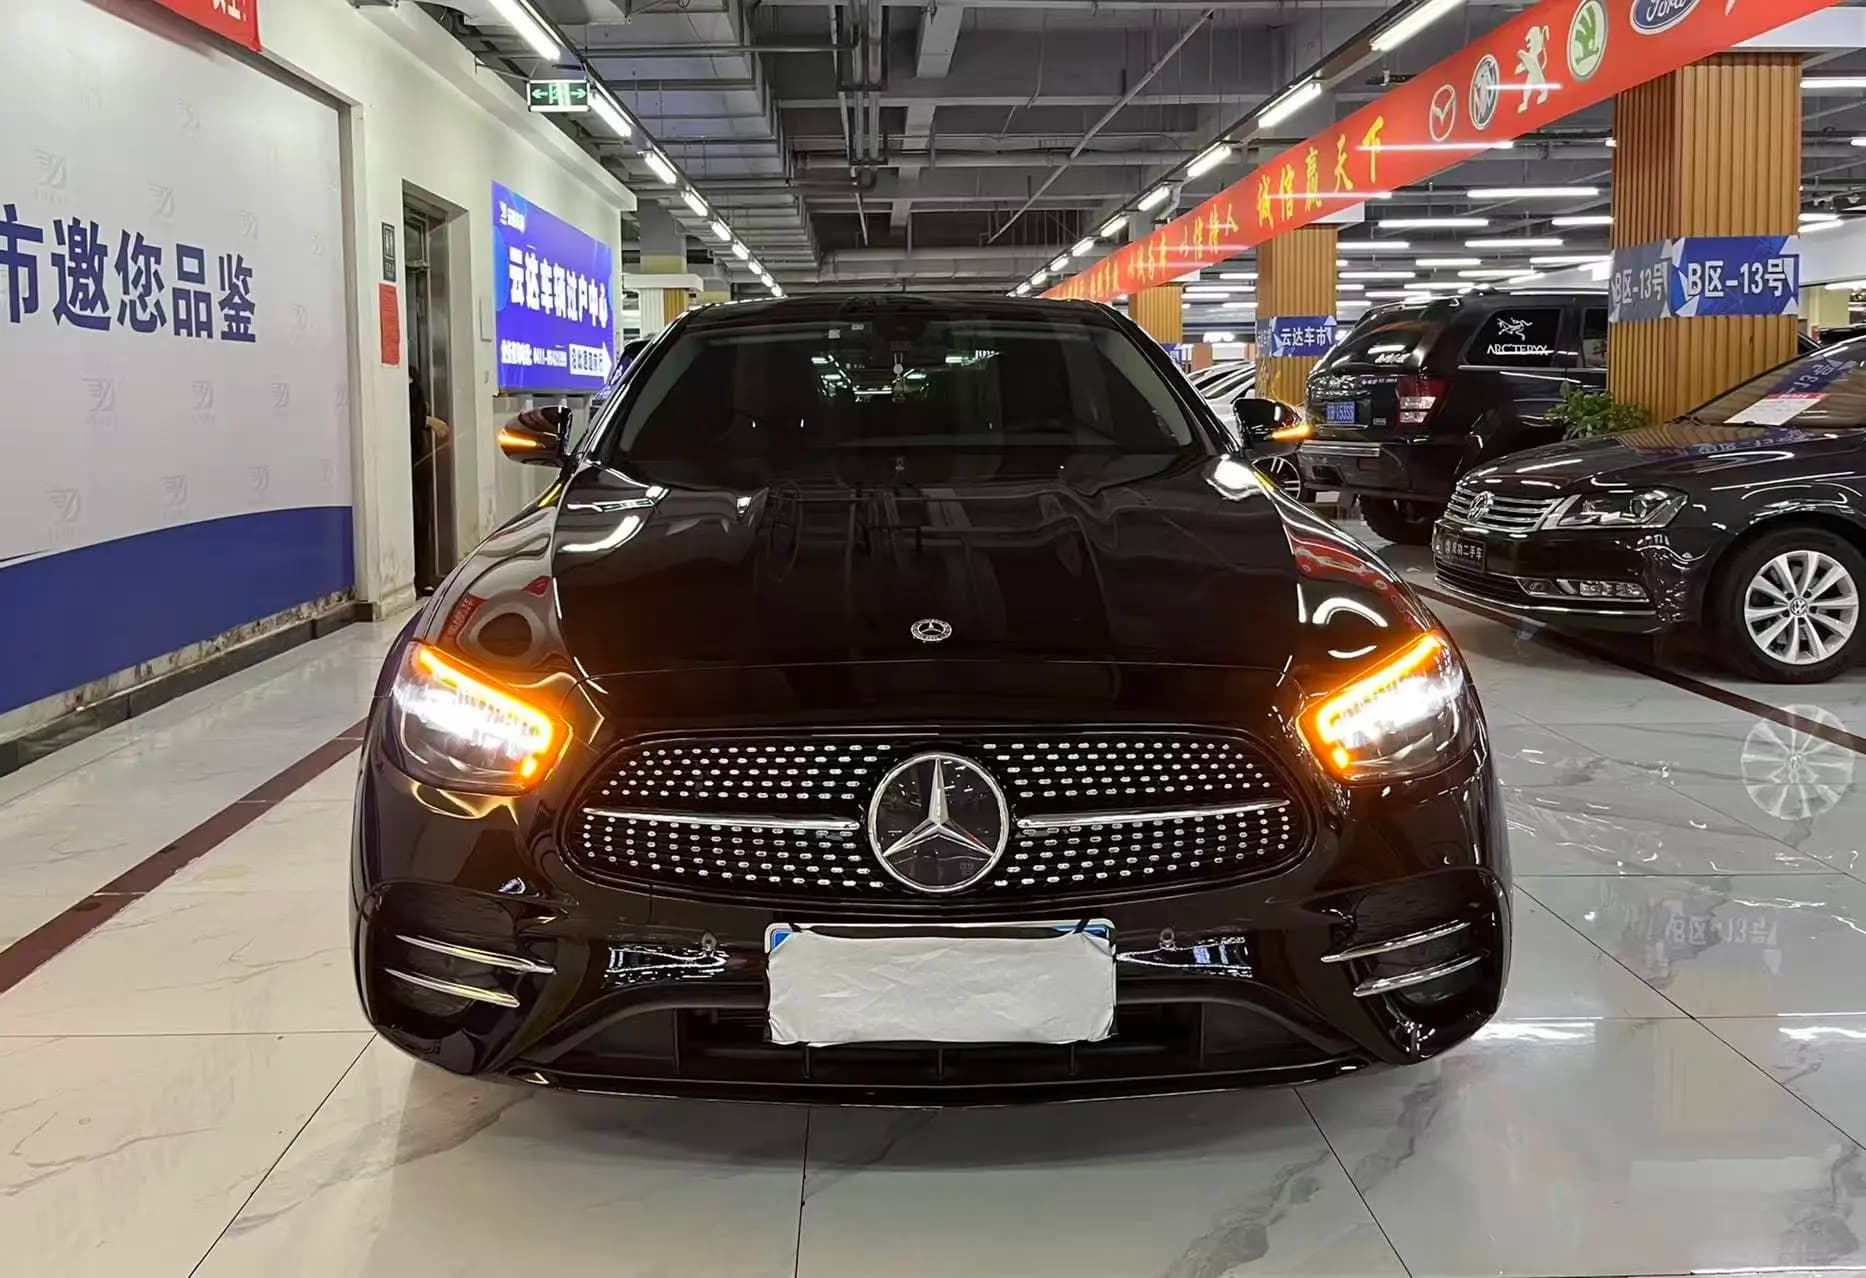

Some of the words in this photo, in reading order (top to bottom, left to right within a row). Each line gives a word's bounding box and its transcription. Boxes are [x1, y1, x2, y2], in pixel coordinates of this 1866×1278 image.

[0, 203, 256, 343] 市邀您品鉴
[1688, 258, 1785, 298] B区-13号
[1281, 327, 1327, 347] 云达车市
